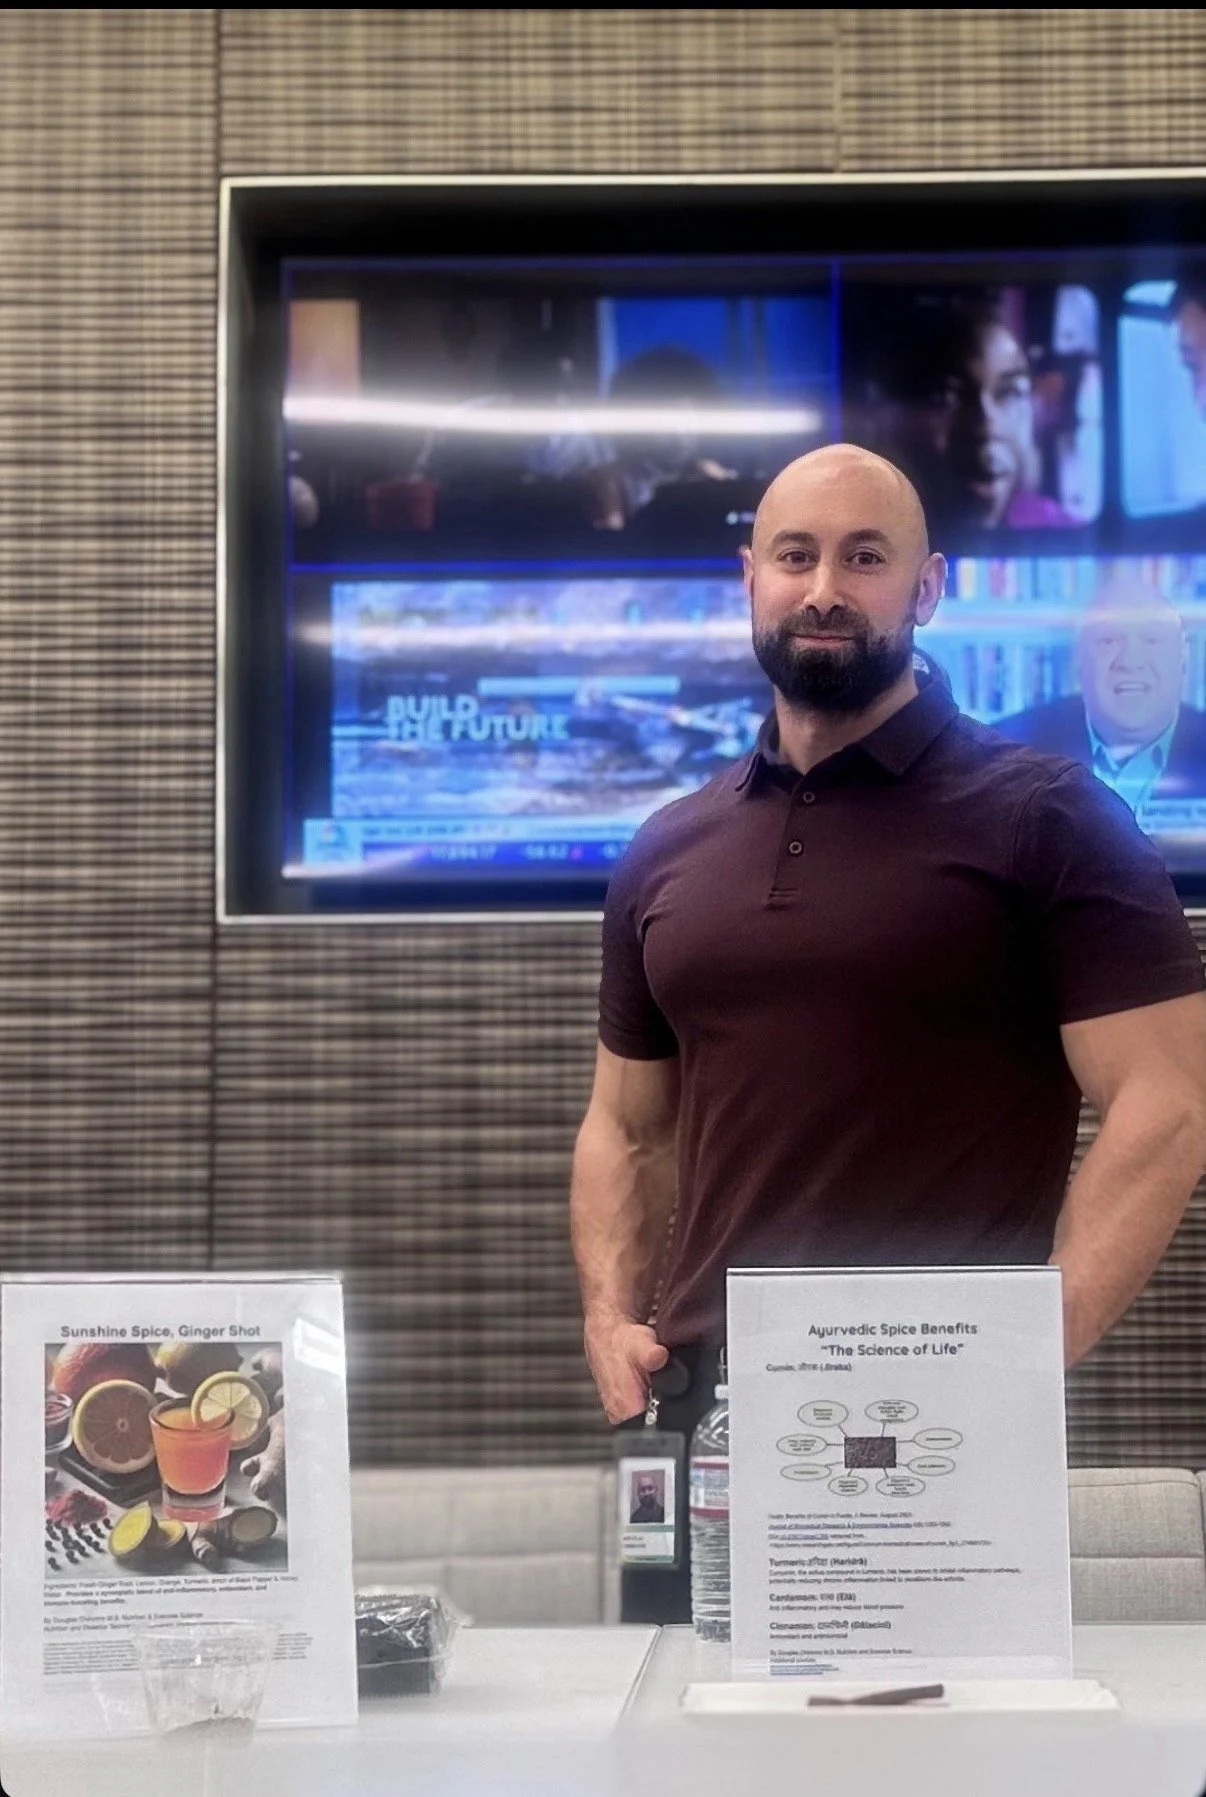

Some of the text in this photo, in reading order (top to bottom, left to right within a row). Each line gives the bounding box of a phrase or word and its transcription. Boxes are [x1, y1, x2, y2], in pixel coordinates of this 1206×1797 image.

[387, 694, 479, 720] BUILD
[386, 713, 568, 741] THE FUTURE
[60, 1324, 261, 1339] Sunshine Spice, Ginger Shot
[808, 1323, 978, 1339] Ayurvedic Spice Benefits
[857, 1344, 910, 1356] Science
[912, 1343, 928, 1355] of
